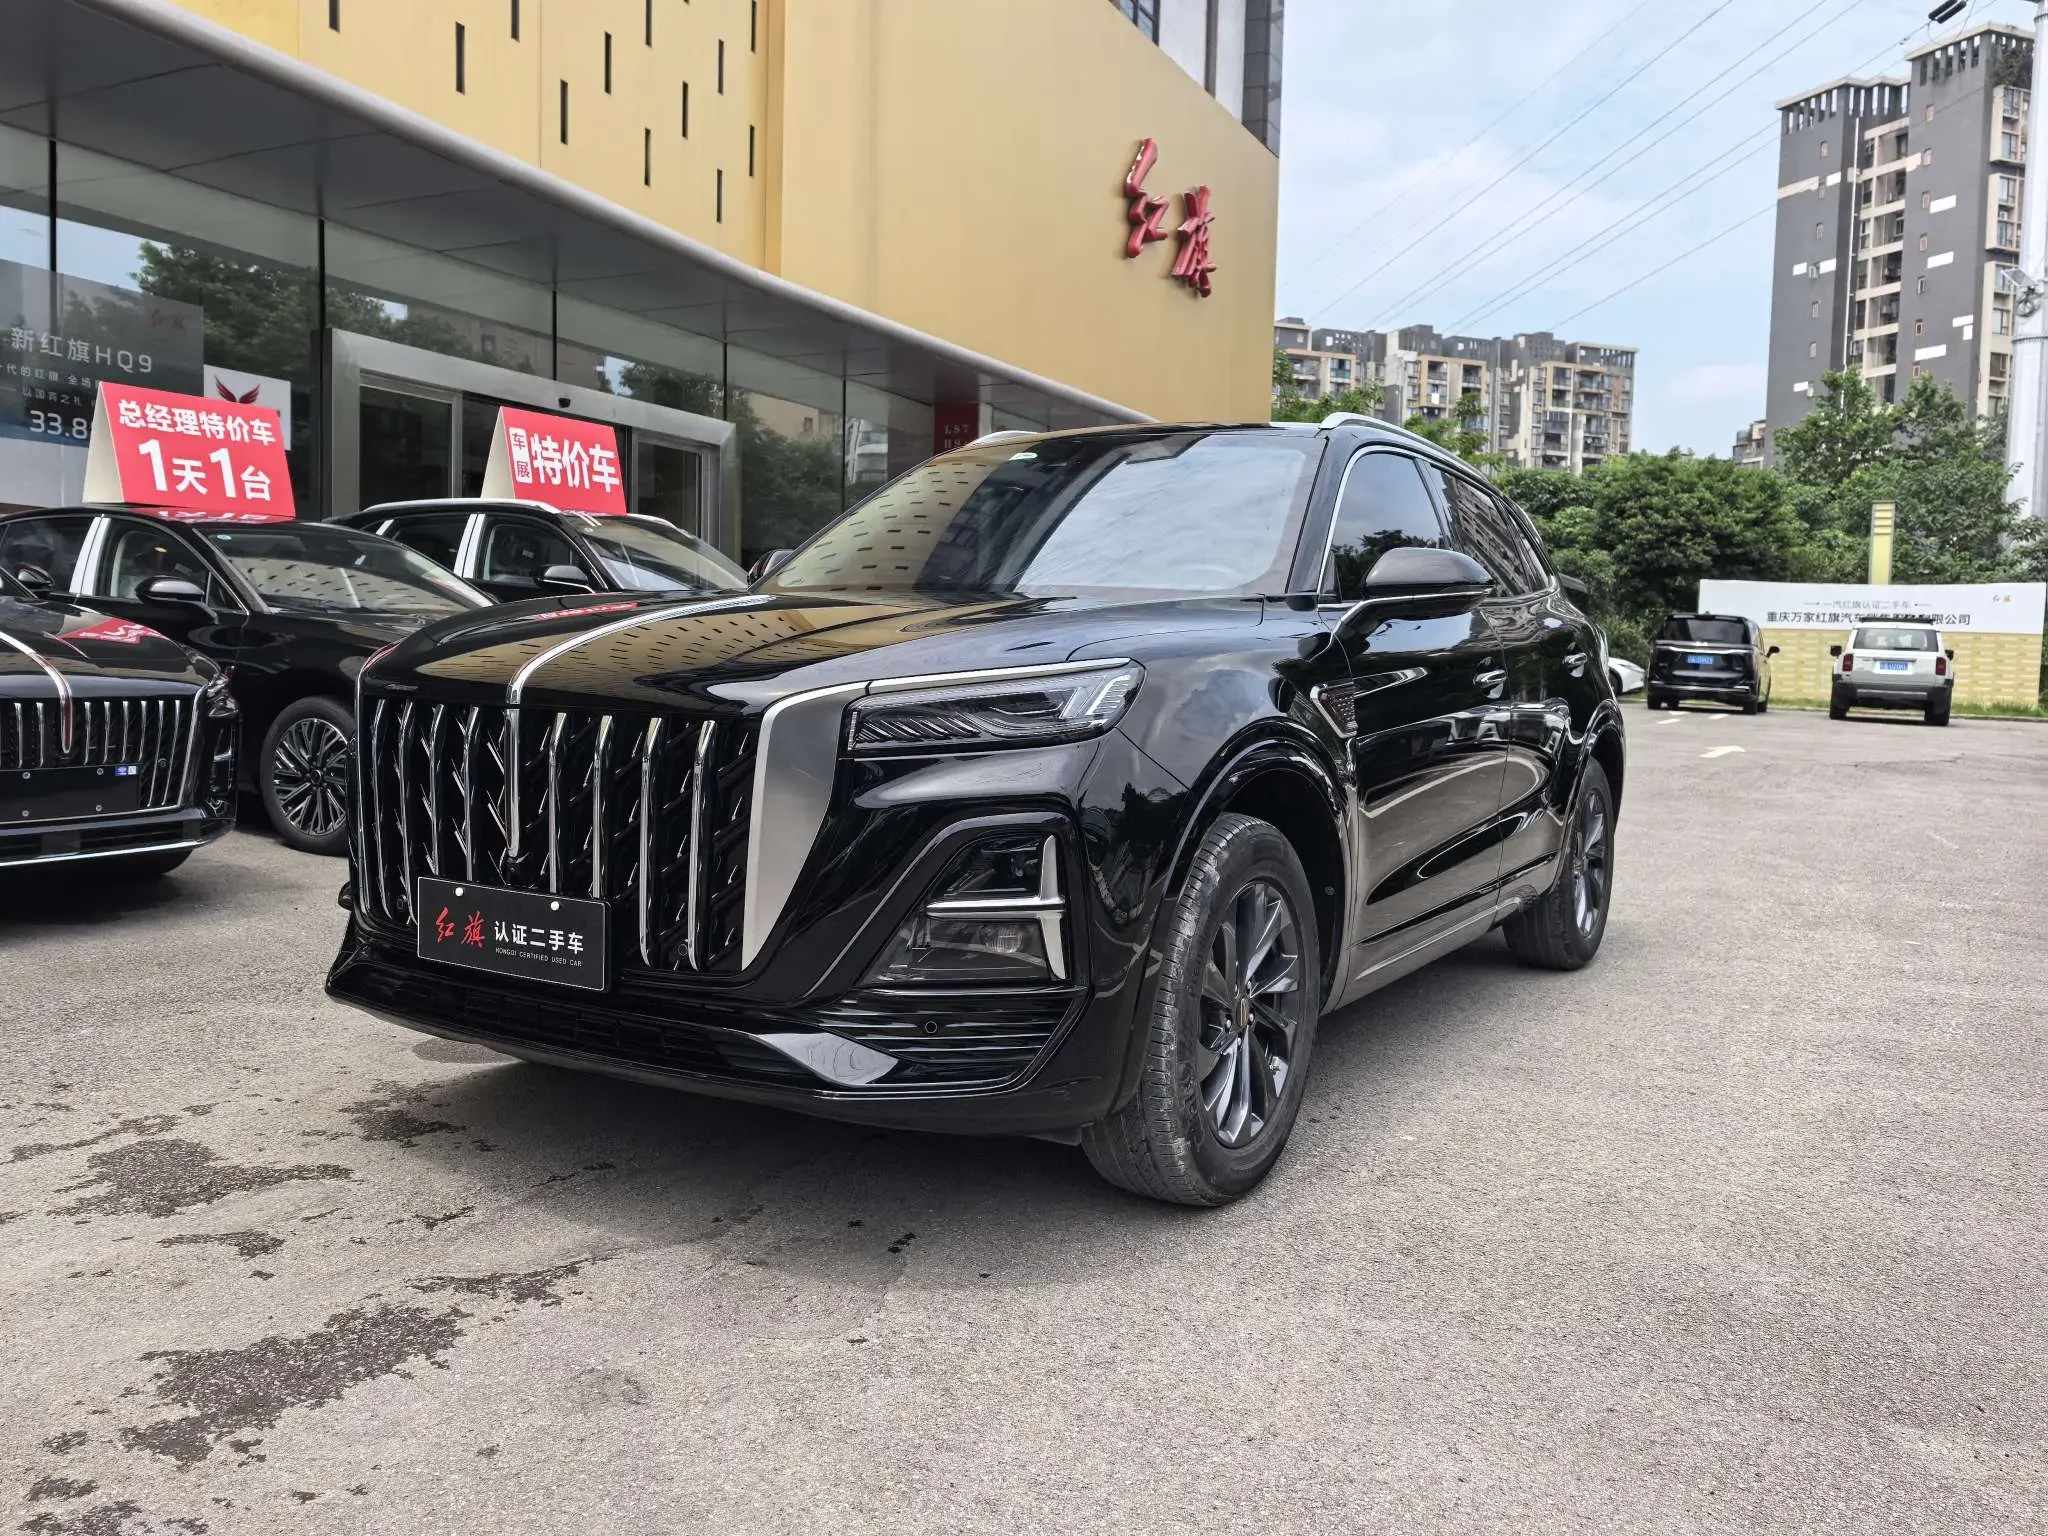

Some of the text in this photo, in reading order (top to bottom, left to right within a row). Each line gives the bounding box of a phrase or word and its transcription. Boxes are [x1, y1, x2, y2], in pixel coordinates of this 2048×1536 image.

[1124, 138, 1218, 298] 红旗
[11, 327, 152, 373] 新红旗HQ9
[30, 410, 88, 440] 33.8
[119, 400, 276, 446] 总经理特价车
[138, 438, 271, 502] 1天1台
[511, 432, 531, 479] 车展
[530, 432, 620, 493] 特价车
[435, 907, 584, 954] 红旗 认证二手车
[519, 951, 549, 962] CERTIFIED
[551, 957, 567, 965] USED
[569, 959, 582, 967] CAR
